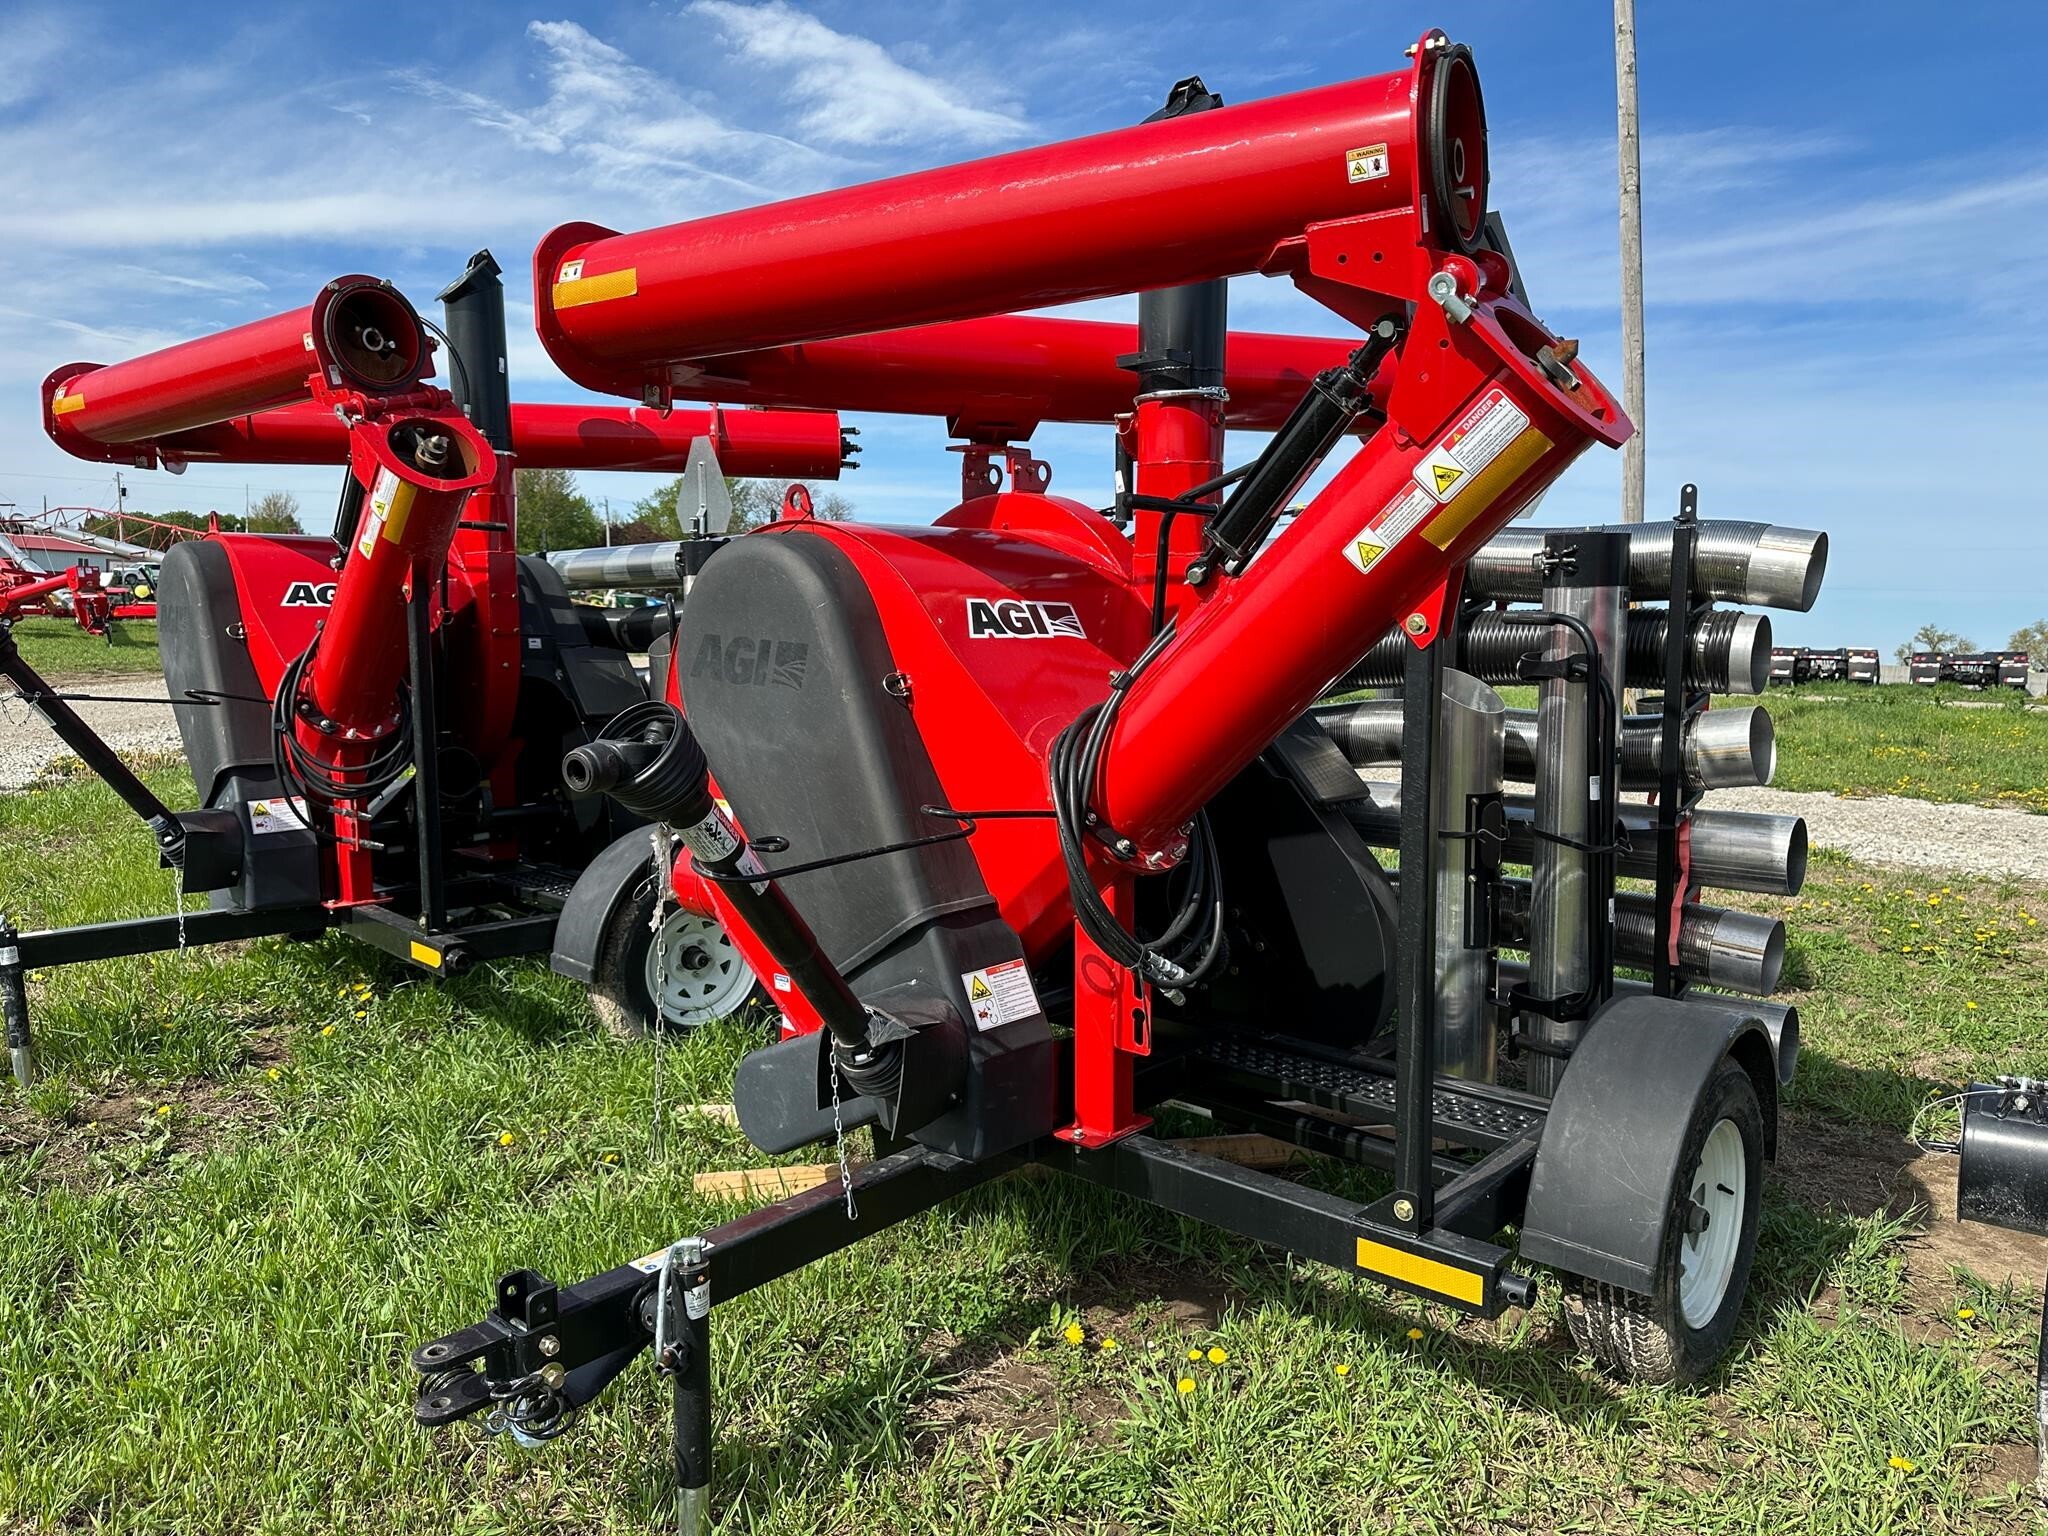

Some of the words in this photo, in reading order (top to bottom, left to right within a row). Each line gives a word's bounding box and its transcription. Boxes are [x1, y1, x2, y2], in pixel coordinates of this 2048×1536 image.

[1355, 147, 1384, 158] WARNING
[1462, 399, 1495, 431] DANGER
[1385, 494, 1406, 515] DANGER
[968, 600, 1051, 637] AGI
[689, 633, 773, 687] AGI
[718, 812, 740, 841] DANGER
